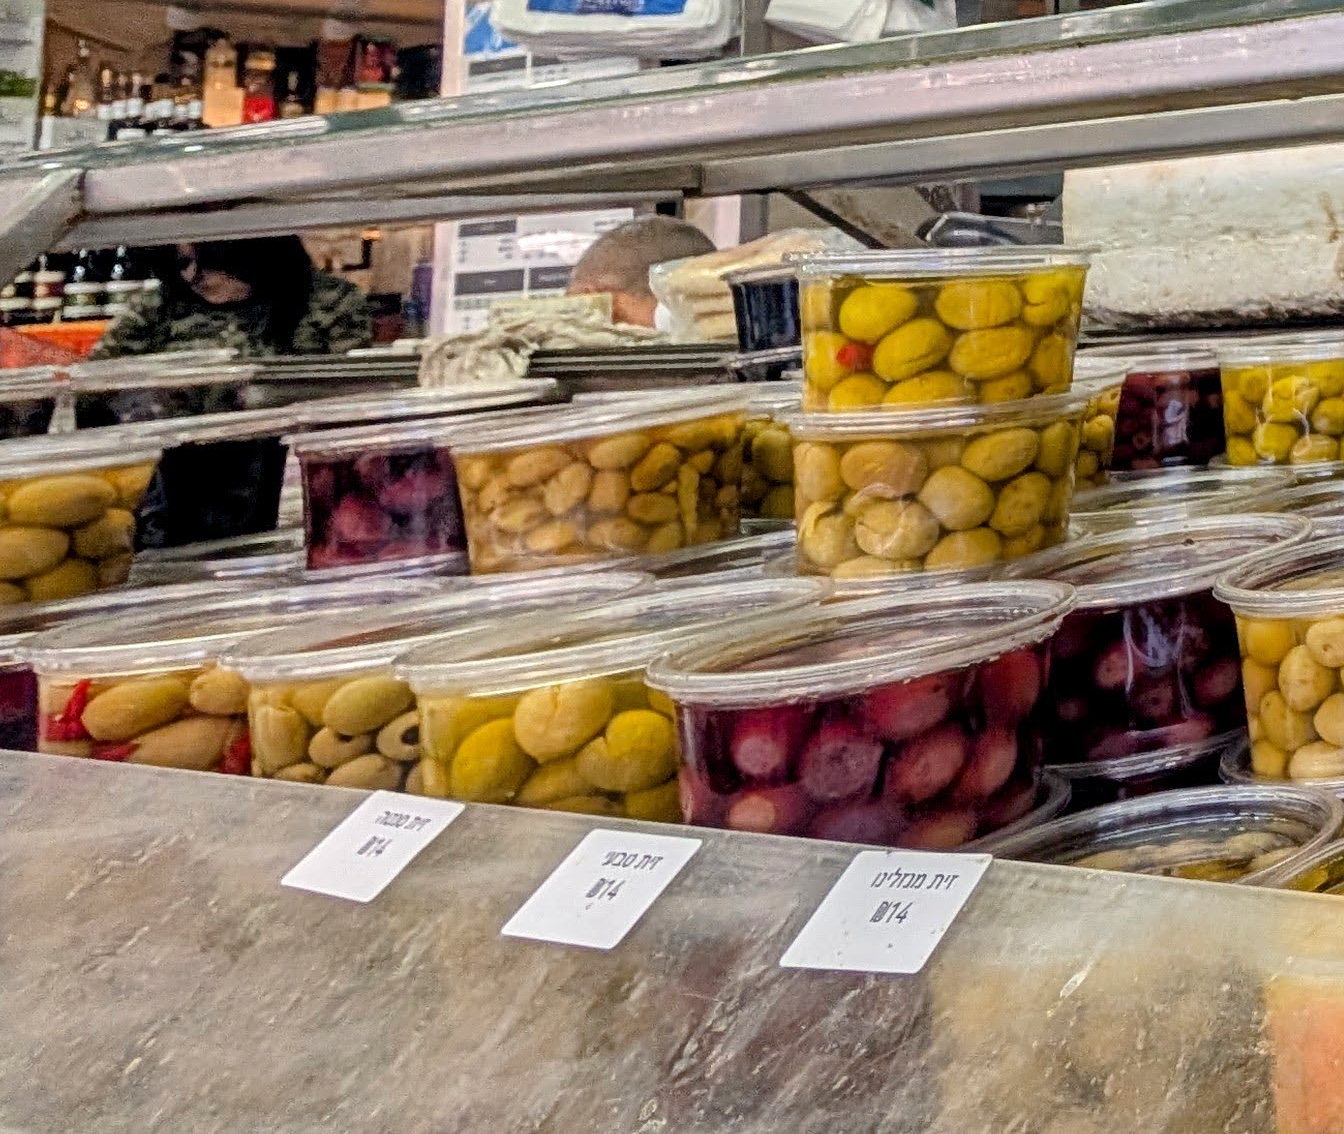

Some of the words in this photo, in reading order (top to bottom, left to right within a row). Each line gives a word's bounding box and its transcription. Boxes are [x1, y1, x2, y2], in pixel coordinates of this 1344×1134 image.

[633, 855, 664, 871] זית
[926, 873, 960, 890] זית
[869, 900, 914, 925] ₪14
